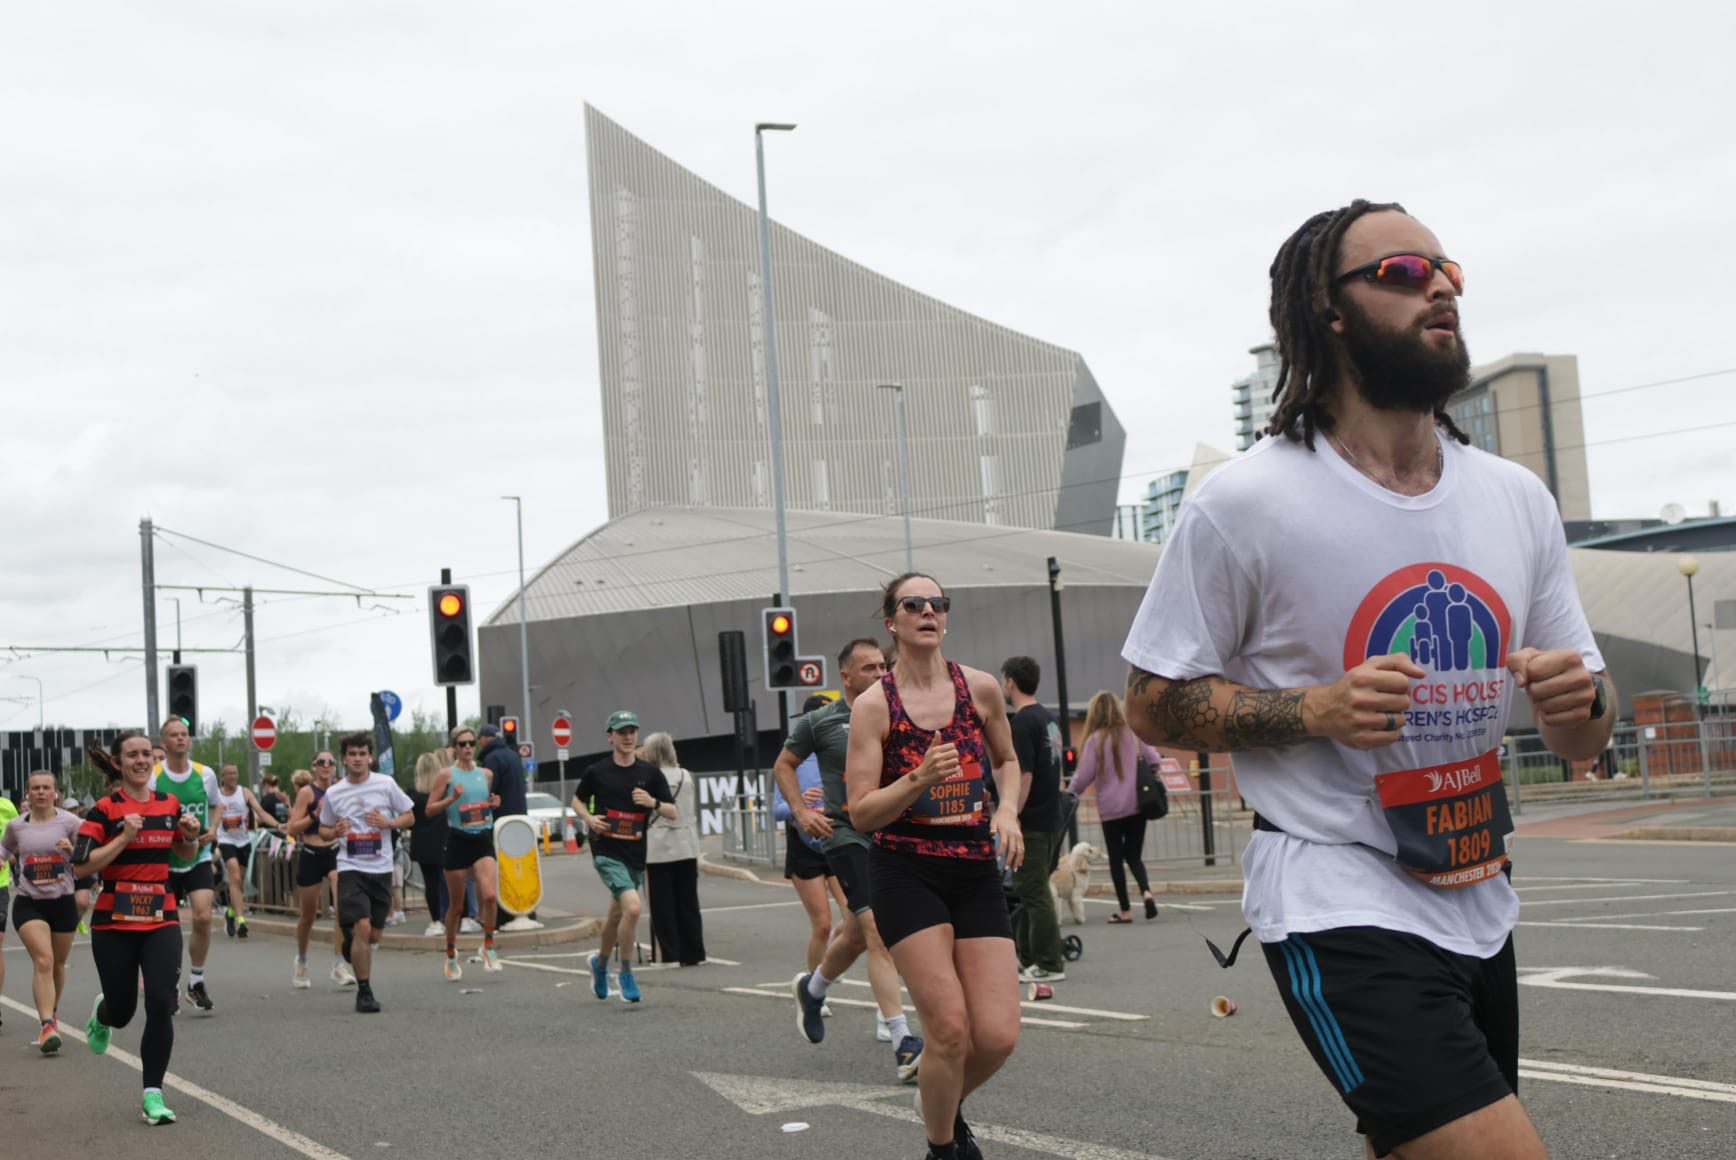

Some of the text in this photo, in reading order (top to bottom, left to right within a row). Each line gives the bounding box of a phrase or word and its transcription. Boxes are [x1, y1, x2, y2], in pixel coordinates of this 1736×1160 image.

[1408, 683, 1448, 704] CIS
[1404, 710, 1452, 726] REN'S
[929, 782, 971, 800] SOPHIE
[939, 799, 966, 815] 1185
[1425, 791, 1493, 835] FABIAN
[1447, 828, 1491, 867] 1809
[1429, 866, 1485, 886] MANCHESTER
[130, 894, 154, 905] VICKY
